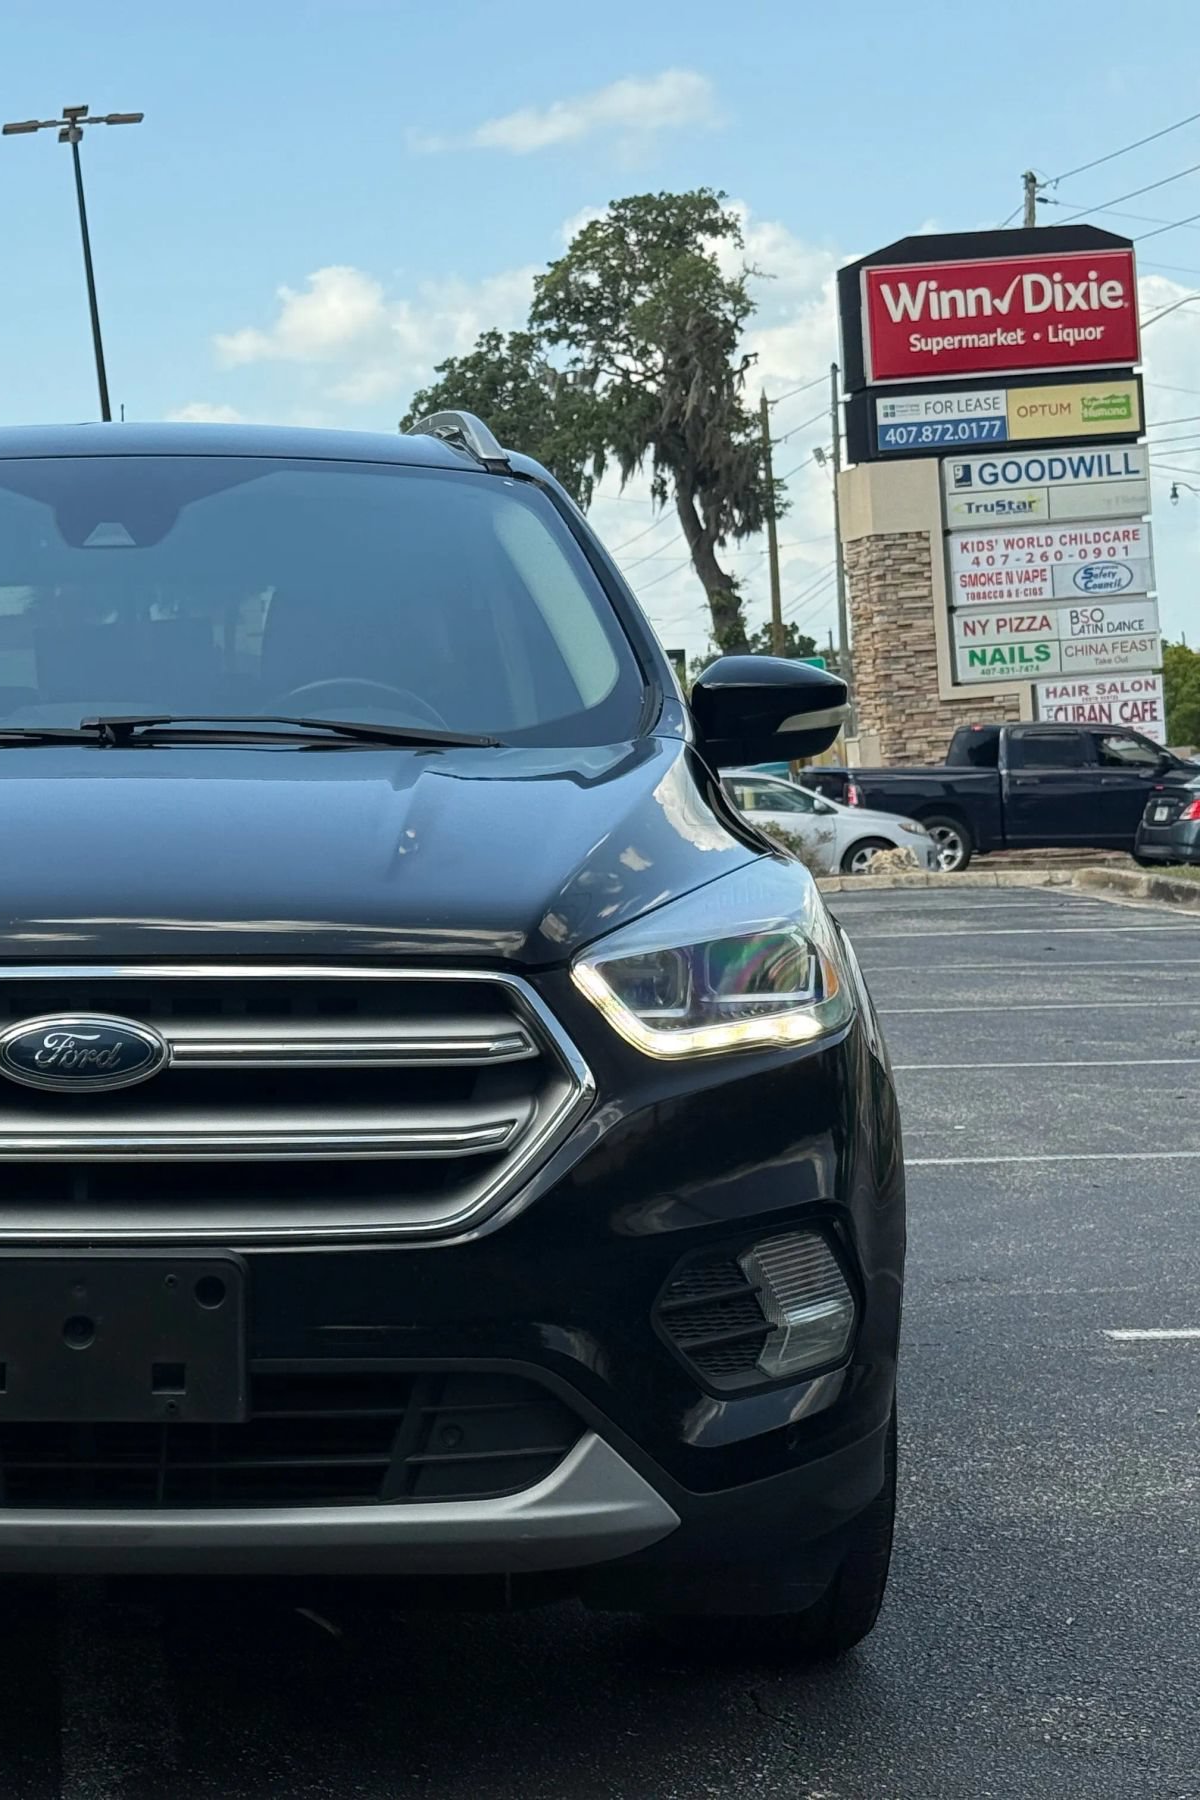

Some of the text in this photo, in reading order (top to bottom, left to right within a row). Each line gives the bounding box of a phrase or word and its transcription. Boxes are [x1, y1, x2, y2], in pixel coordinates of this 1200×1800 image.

[880, 271, 1124, 323] Winn Dixie
[909, 325, 1105, 355] Supermarket Liquor
[924, 400, 953, 415] FOR
[957, 397, 1001, 413] LEASE
[1016, 403, 1072, 418] OPTUM
[885, 420, 1001, 445] 407.872.0177
[978, 453, 1140, 486] GOODWILL
[964, 499, 1036, 514] TruStar
[960, 529, 1141, 554] KIDS' WORLD CHILDCARE
[960, 568, 1048, 588] SMOKE N VAPE
[965, 589, 1004, 601] TOBACCO
[963, 615, 1052, 637] NY PIZZA
[1070, 608, 1104, 625] BSO
[1071, 619, 1145, 636] LATIN DANCE
[968, 644, 1051, 667] NAILS
[1064, 638, 1157, 658] CHINA FEAST
[1095, 657, 1112, 665] Take
[1045, 684, 1089, 699] HAIR
[1096, 679, 1157, 695] SALON
[1119, 700, 1158, 722] CAFE
[34, 1032, 123, 1069] Ford
